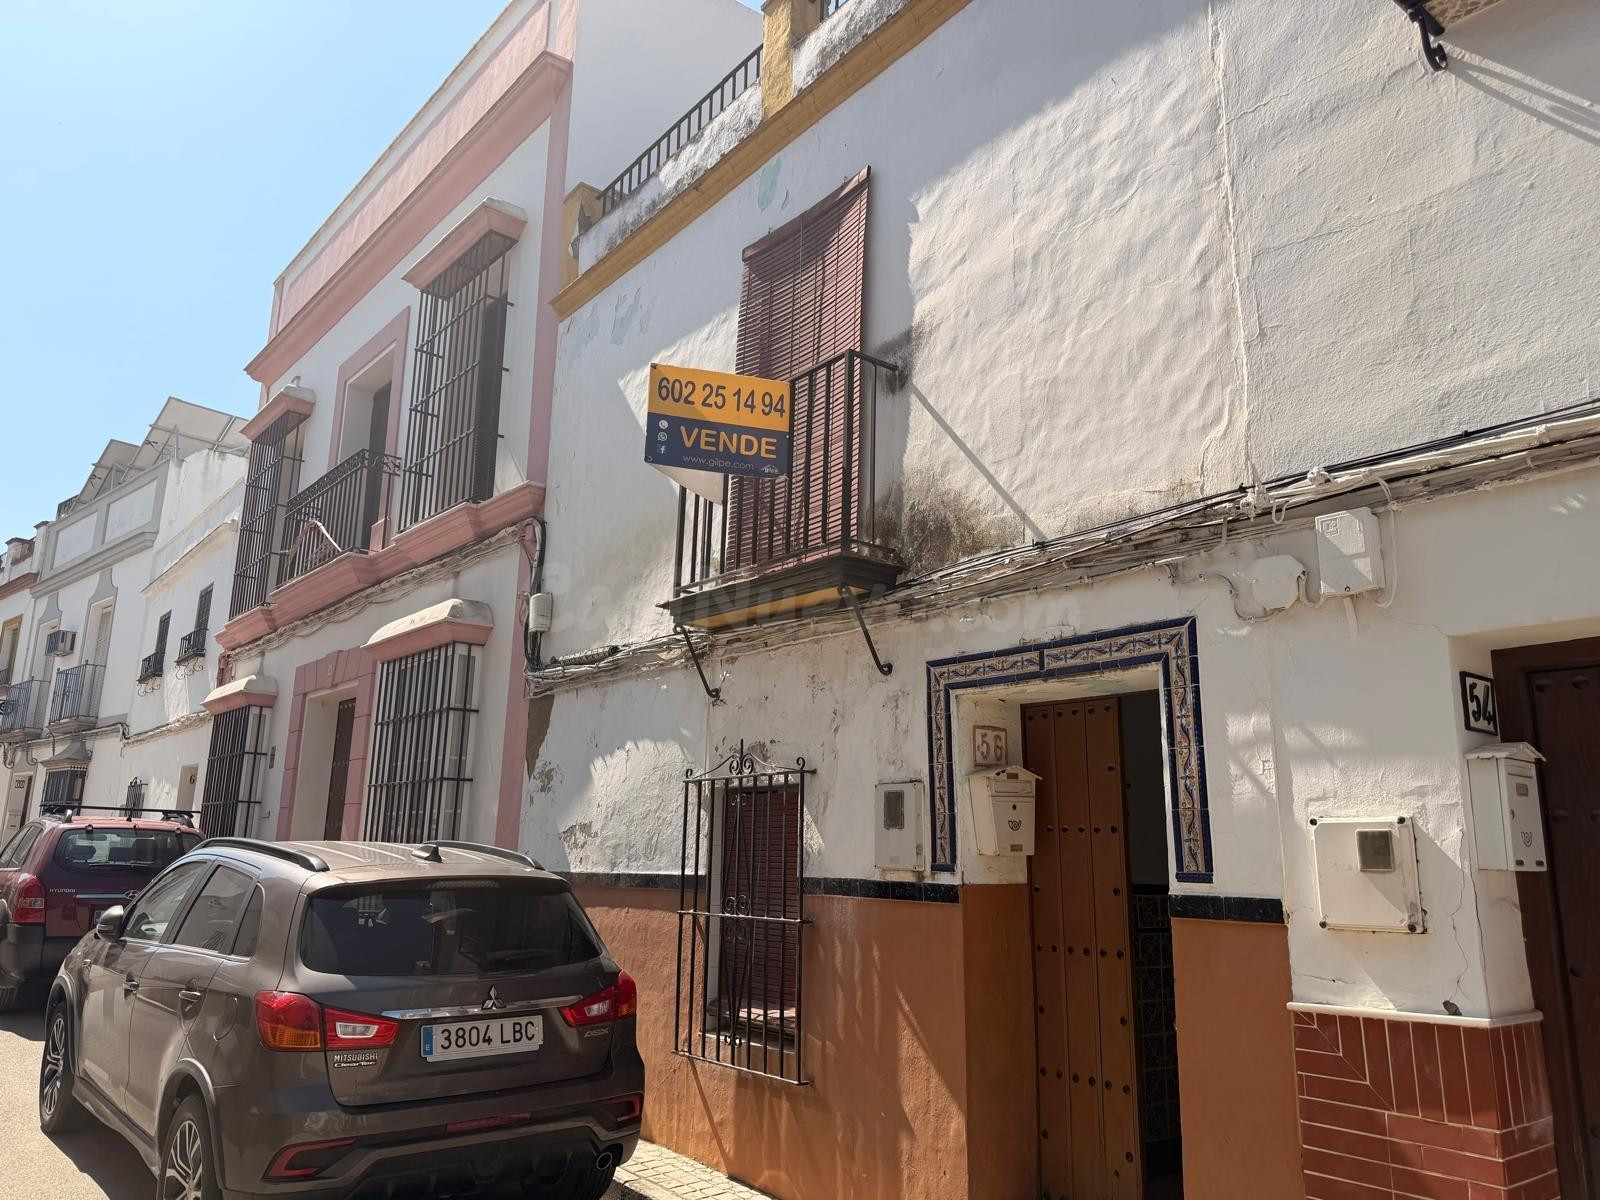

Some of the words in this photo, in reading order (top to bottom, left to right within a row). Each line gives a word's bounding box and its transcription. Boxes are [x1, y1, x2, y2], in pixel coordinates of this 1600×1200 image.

[657, 377, 696, 406] 602
[701, 383, 727, 410] 25
[732, 387, 756, 414] 14
[761, 391, 786, 418] 94
[680, 425, 777, 459] VENDE
[1468, 682, 1495, 726] 54
[979, 732, 1004, 762] 56
[440, 1024, 493, 1050] 3804
[500, 1021, 535, 1045] LBC
[583, 1027, 609, 1038] ASX
[333, 1052, 378, 1062] MITSUBISHI
